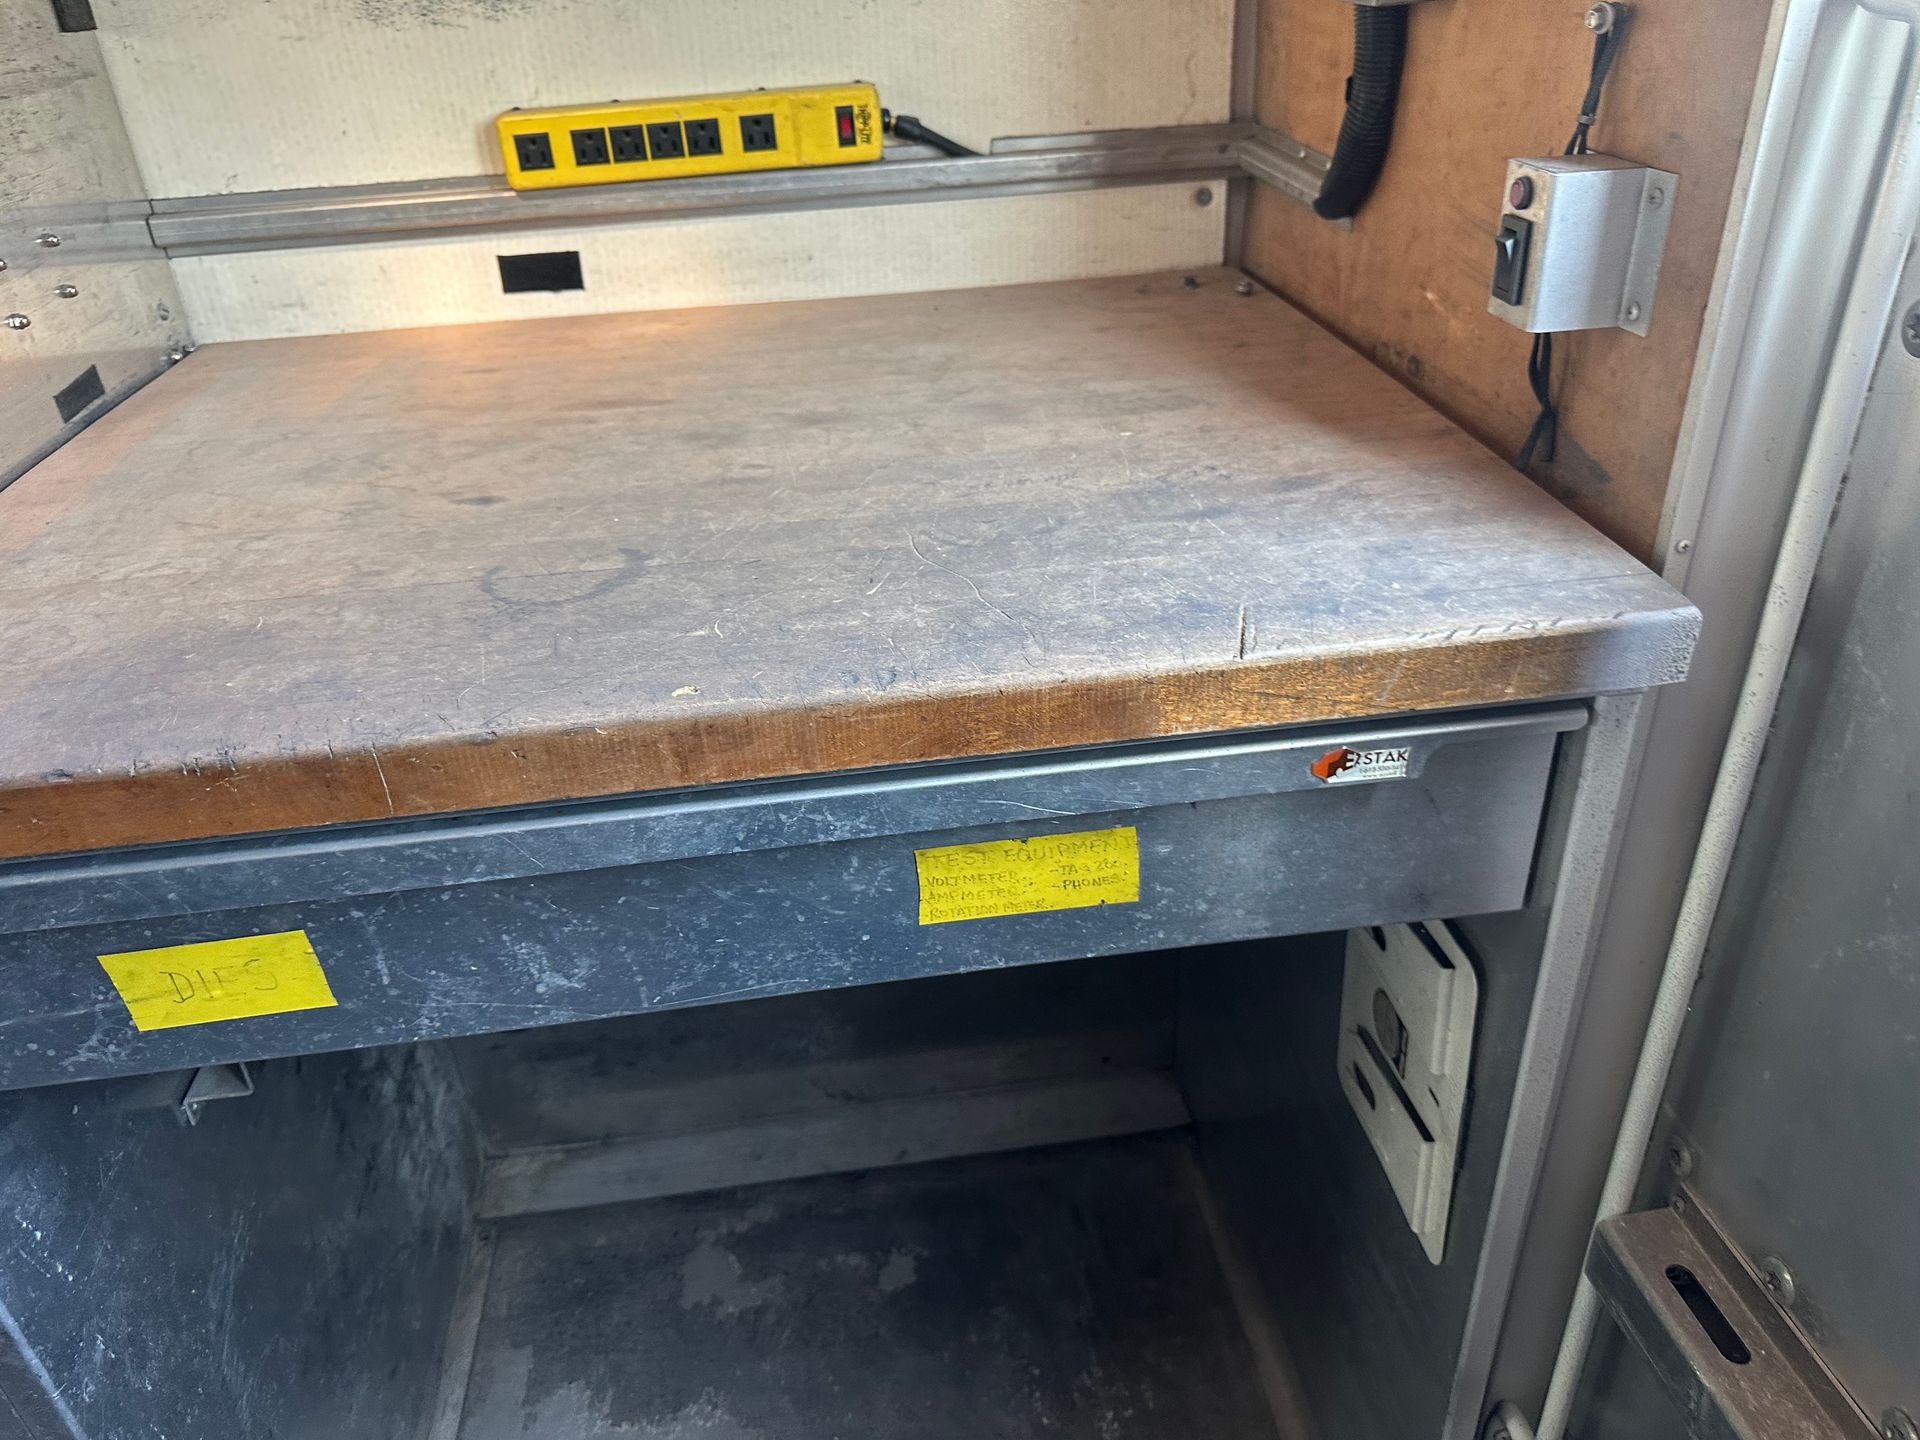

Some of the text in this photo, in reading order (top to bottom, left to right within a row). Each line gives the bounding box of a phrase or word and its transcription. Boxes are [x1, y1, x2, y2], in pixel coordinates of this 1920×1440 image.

[925, 835, 1137, 868] TEST EQUIPMENT
[929, 903, 998, 921] ROTATION
[160, 959, 278, 1003] DIES
